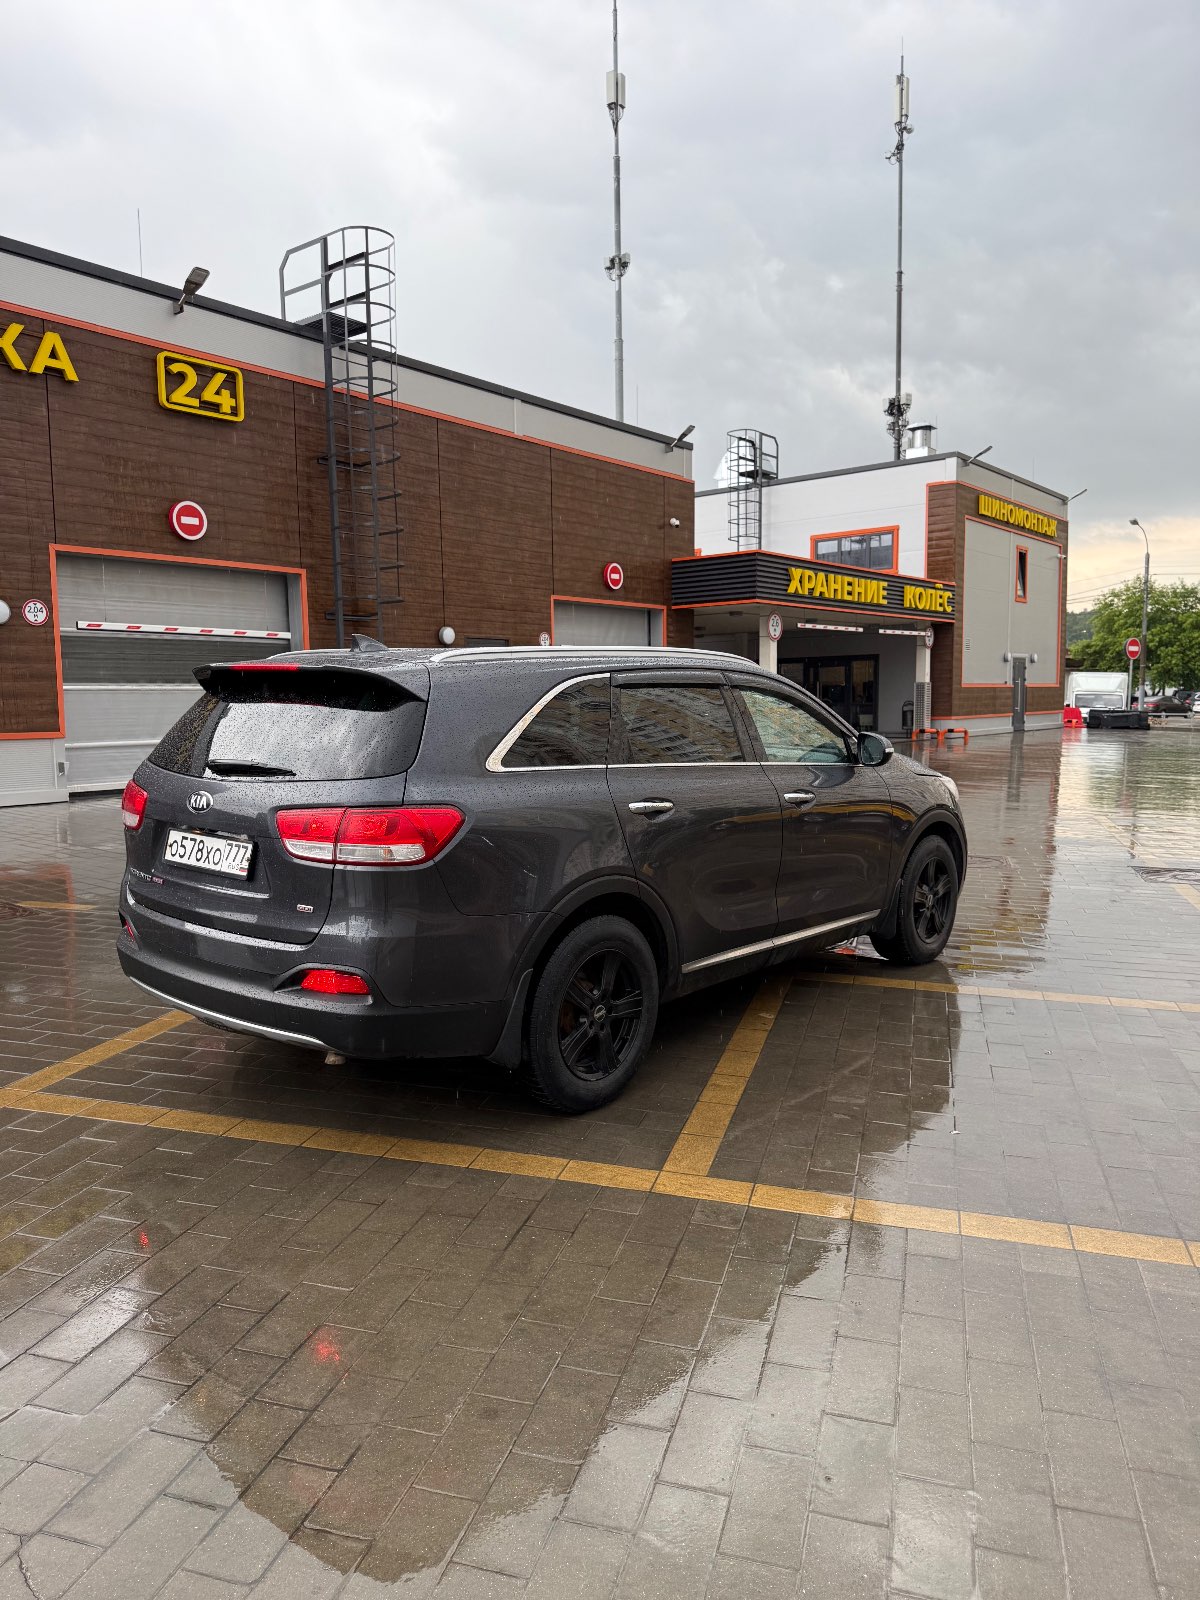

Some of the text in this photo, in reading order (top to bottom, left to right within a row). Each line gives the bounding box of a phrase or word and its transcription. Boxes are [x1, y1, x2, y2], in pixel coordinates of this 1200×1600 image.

[166, 362, 236, 414] 24
[978, 494, 1057, 537] ШИНОМОНТАЖ
[786, 567, 953, 613] ХРАНЕНИЕ КОЛЁС
[190, 794, 208, 809] KIA
